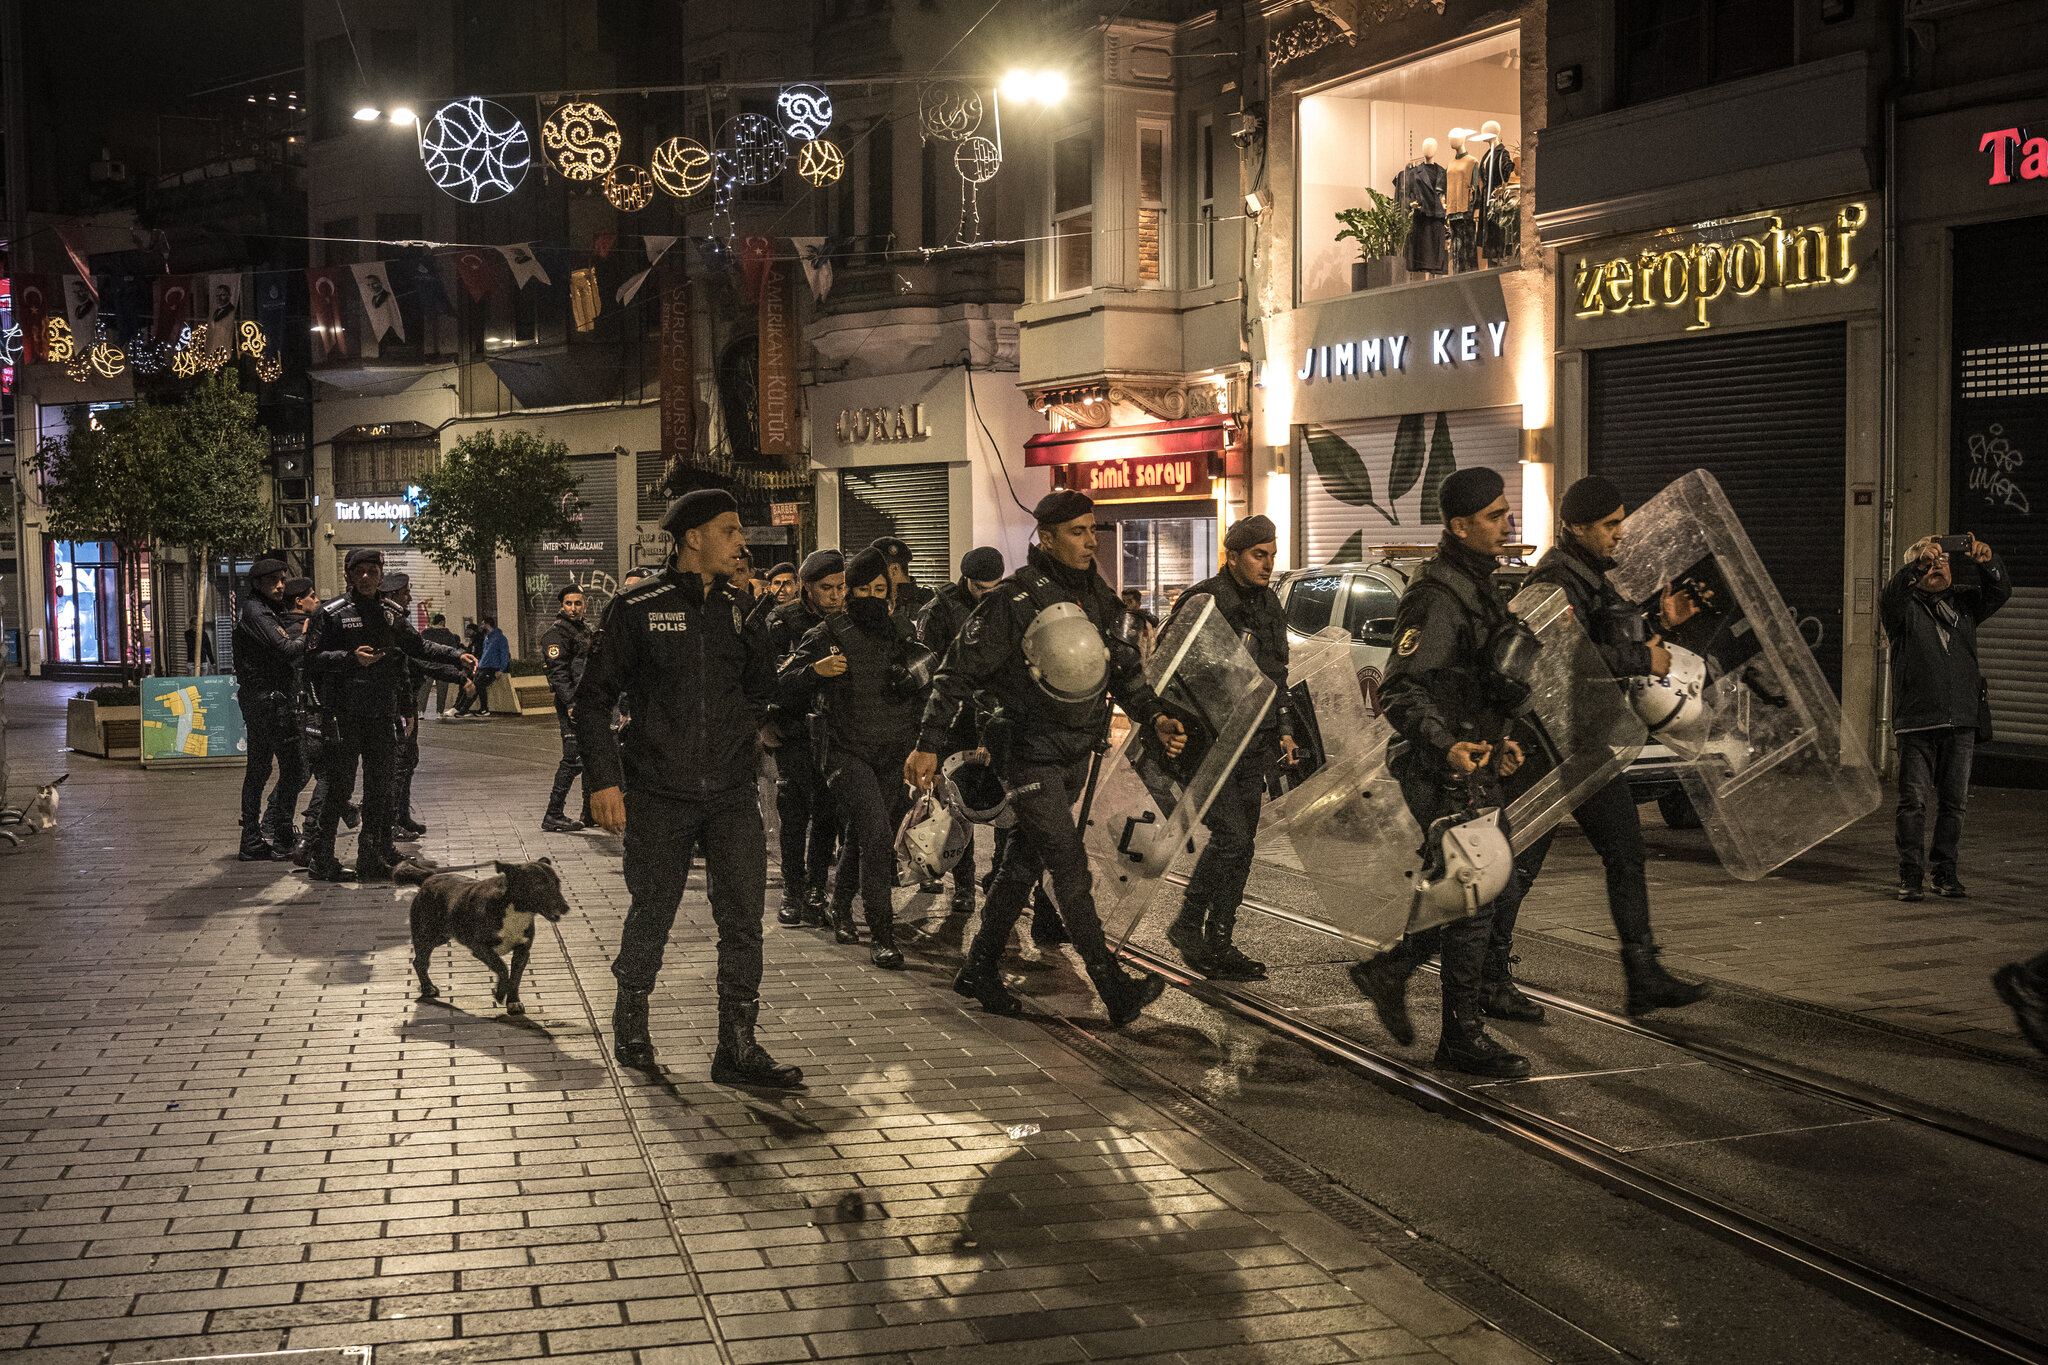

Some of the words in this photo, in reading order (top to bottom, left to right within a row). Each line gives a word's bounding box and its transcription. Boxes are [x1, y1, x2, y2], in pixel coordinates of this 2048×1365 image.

[1979, 127, 2048, 185] Ta
[1574, 208, 1862, 330] zeropoint
[1297, 335, 1405, 381] JIMMY
[1433, 320, 1507, 365] KEY
[672, 385, 689, 451] KURSU
[767, 375, 788, 444] KÜLTÜR
[836, 403, 932, 442] CORAL
[1090, 459, 1130, 490] simit
[1135, 461, 1192, 493] sarayı
[335, 501, 360, 519] Türk
[361, 500, 410, 519] Telekom
[772, 504, 798, 515] BARBER
[542, 541, 569, 551] İNTERT
[554, 555, 595, 565] flormar.com.tr
